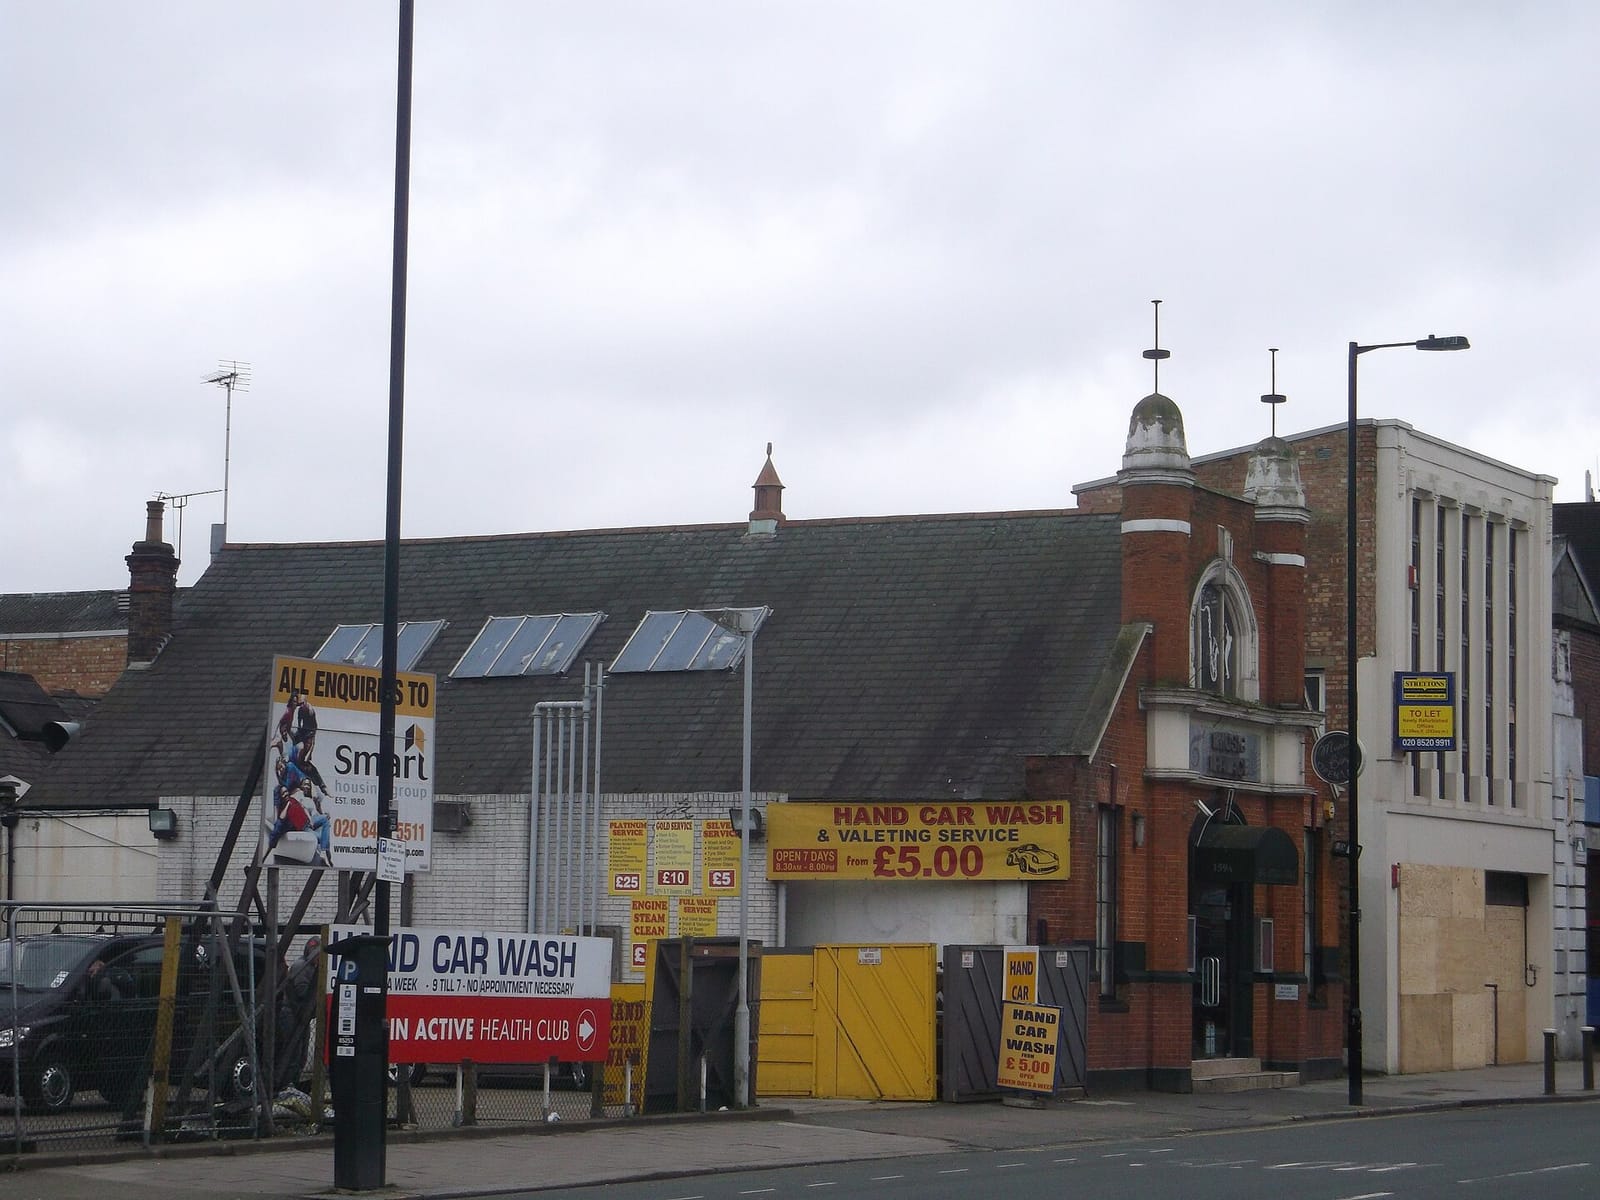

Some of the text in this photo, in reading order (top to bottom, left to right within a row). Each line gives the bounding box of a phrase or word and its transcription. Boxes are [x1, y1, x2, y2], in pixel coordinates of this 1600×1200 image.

[279, 667, 309, 695] ALL
[408, 681, 429, 708] TO
[335, 780, 376, 794] housin
[350, 797, 366, 806] 1980
[833, 805, 1064, 825] HAND CAR WASH
[333, 818, 424, 841] 020 84 5511
[656, 822, 692, 830] GOLD SERVICE
[817, 829, 1019, 842] & VALETING SERVICE
[775, 851, 835, 861] OPEN 7 DAYS
[846, 845, 984, 877] from £5.00
[775, 863, 802, 871] 8.30AM
[808, 863, 835, 871] 8.00PM
[615, 877, 639, 888] £25
[662, 871, 684, 884] £10
[712, 872, 731, 885] £5
[632, 900, 667, 910] ENGINE
[633, 913, 665, 923] STEAM
[634, 926, 665, 936] CLEAN
[433, 934, 488, 975] CAR
[498, 937, 577, 978] WASH
[1010, 960, 1033, 976] HAND
[395, 978, 418, 991] WEEK
[432, 979, 437, 991] 9
[440, 979, 454, 992] TILL
[457, 980, 461, 992] 7
[467, 980, 478, 993] NO
[480, 980, 533, 994] APPOINTMENT
[534, 982, 575, 995] NECESSARY
[1012, 985, 1029, 1001] CAR
[611, 1001, 645, 1021] AND
[1012, 1008, 1057, 1025] HAND
[415, 1018, 475, 1041] ACTIVE
[480, 1019, 532, 1041] HEALTH
[538, 1019, 570, 1040] CLUB
[610, 1025, 637, 1044] CAR
[1015, 1024, 1047, 1039] CAR
[1006, 1038, 1055, 1056] WASH
[1018, 1059, 1050, 1074] 5.00
[1019, 1072, 1035, 1080] OPEN
[1016, 1080, 1032, 1088] DAYS
